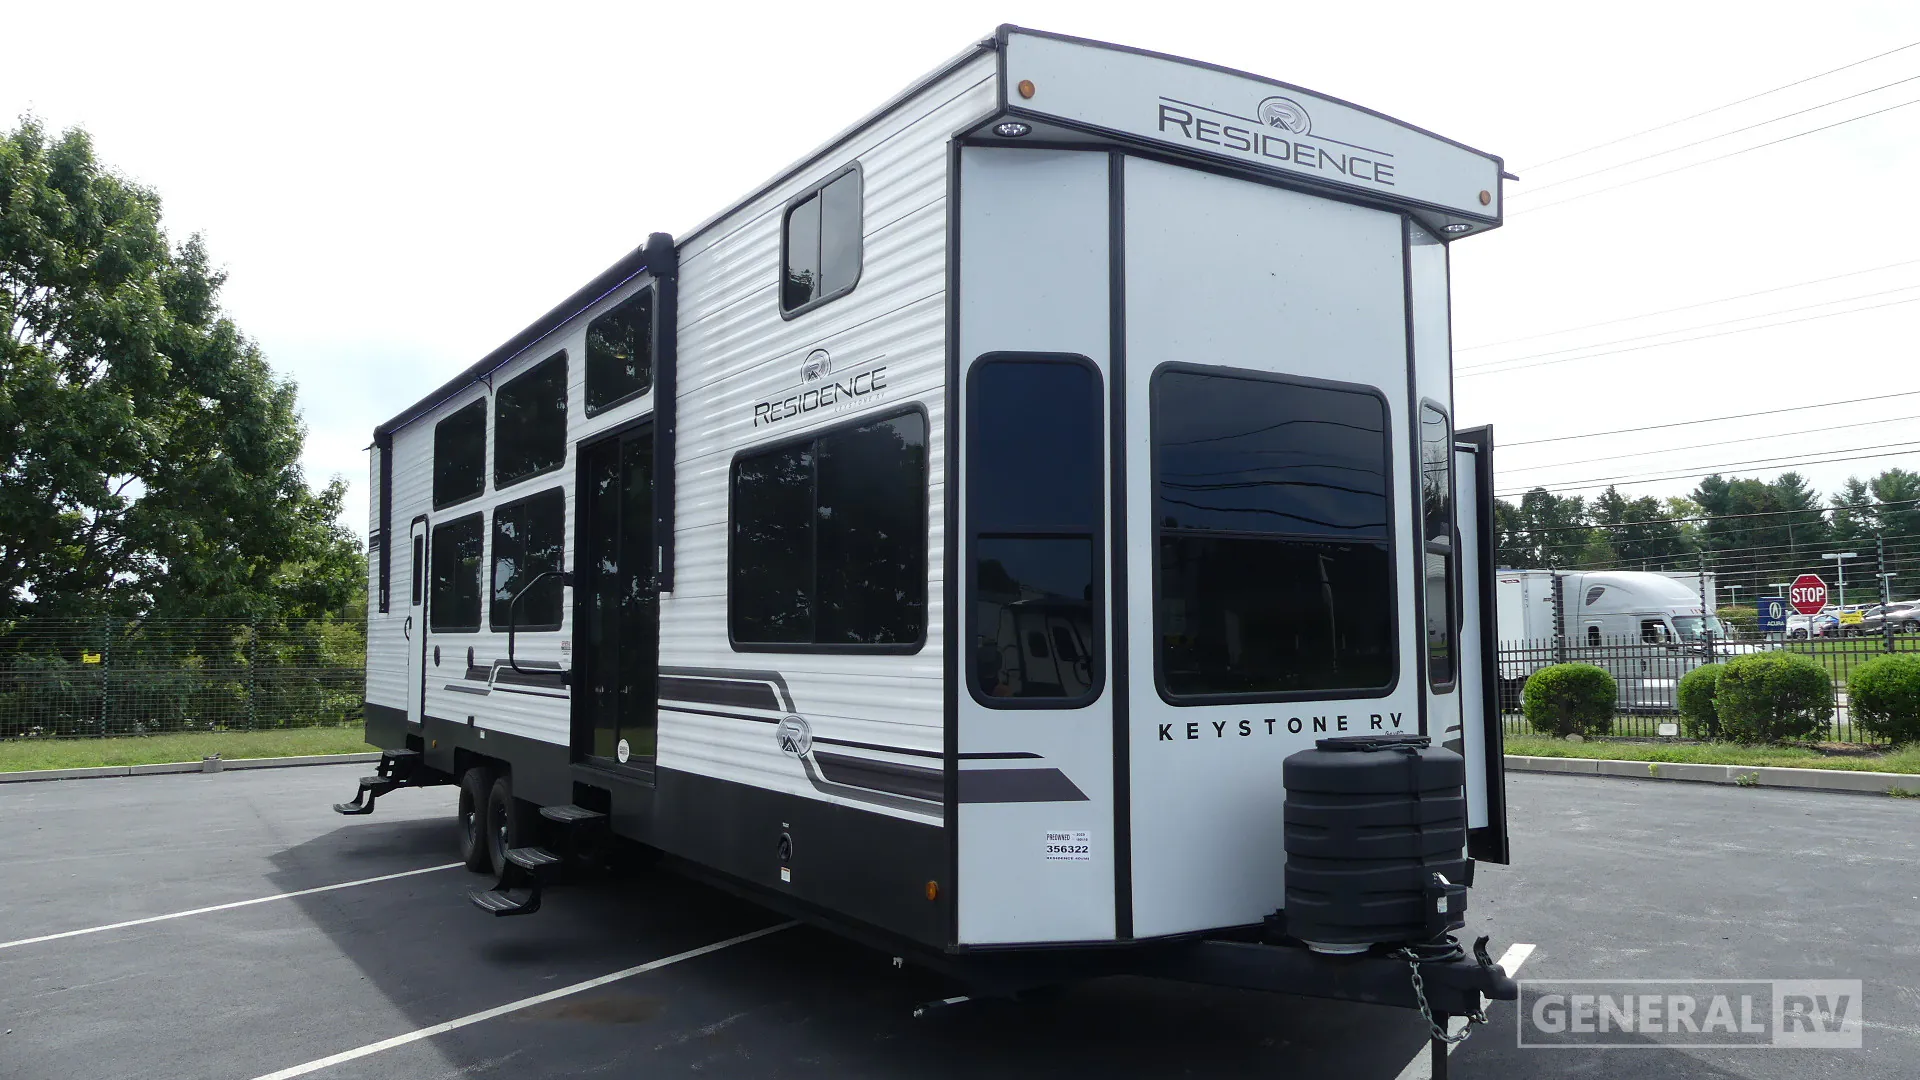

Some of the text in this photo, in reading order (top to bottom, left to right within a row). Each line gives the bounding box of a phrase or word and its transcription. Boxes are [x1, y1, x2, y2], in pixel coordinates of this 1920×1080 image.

[1158, 103, 1395, 186] RESIDENCE
[753, 366, 887, 427] RESIDENCE
[1792, 587, 1824, 603] STOP
[1158, 712, 1402, 741] KEYSTONE RV
[1046, 845, 1089, 854] 356322
